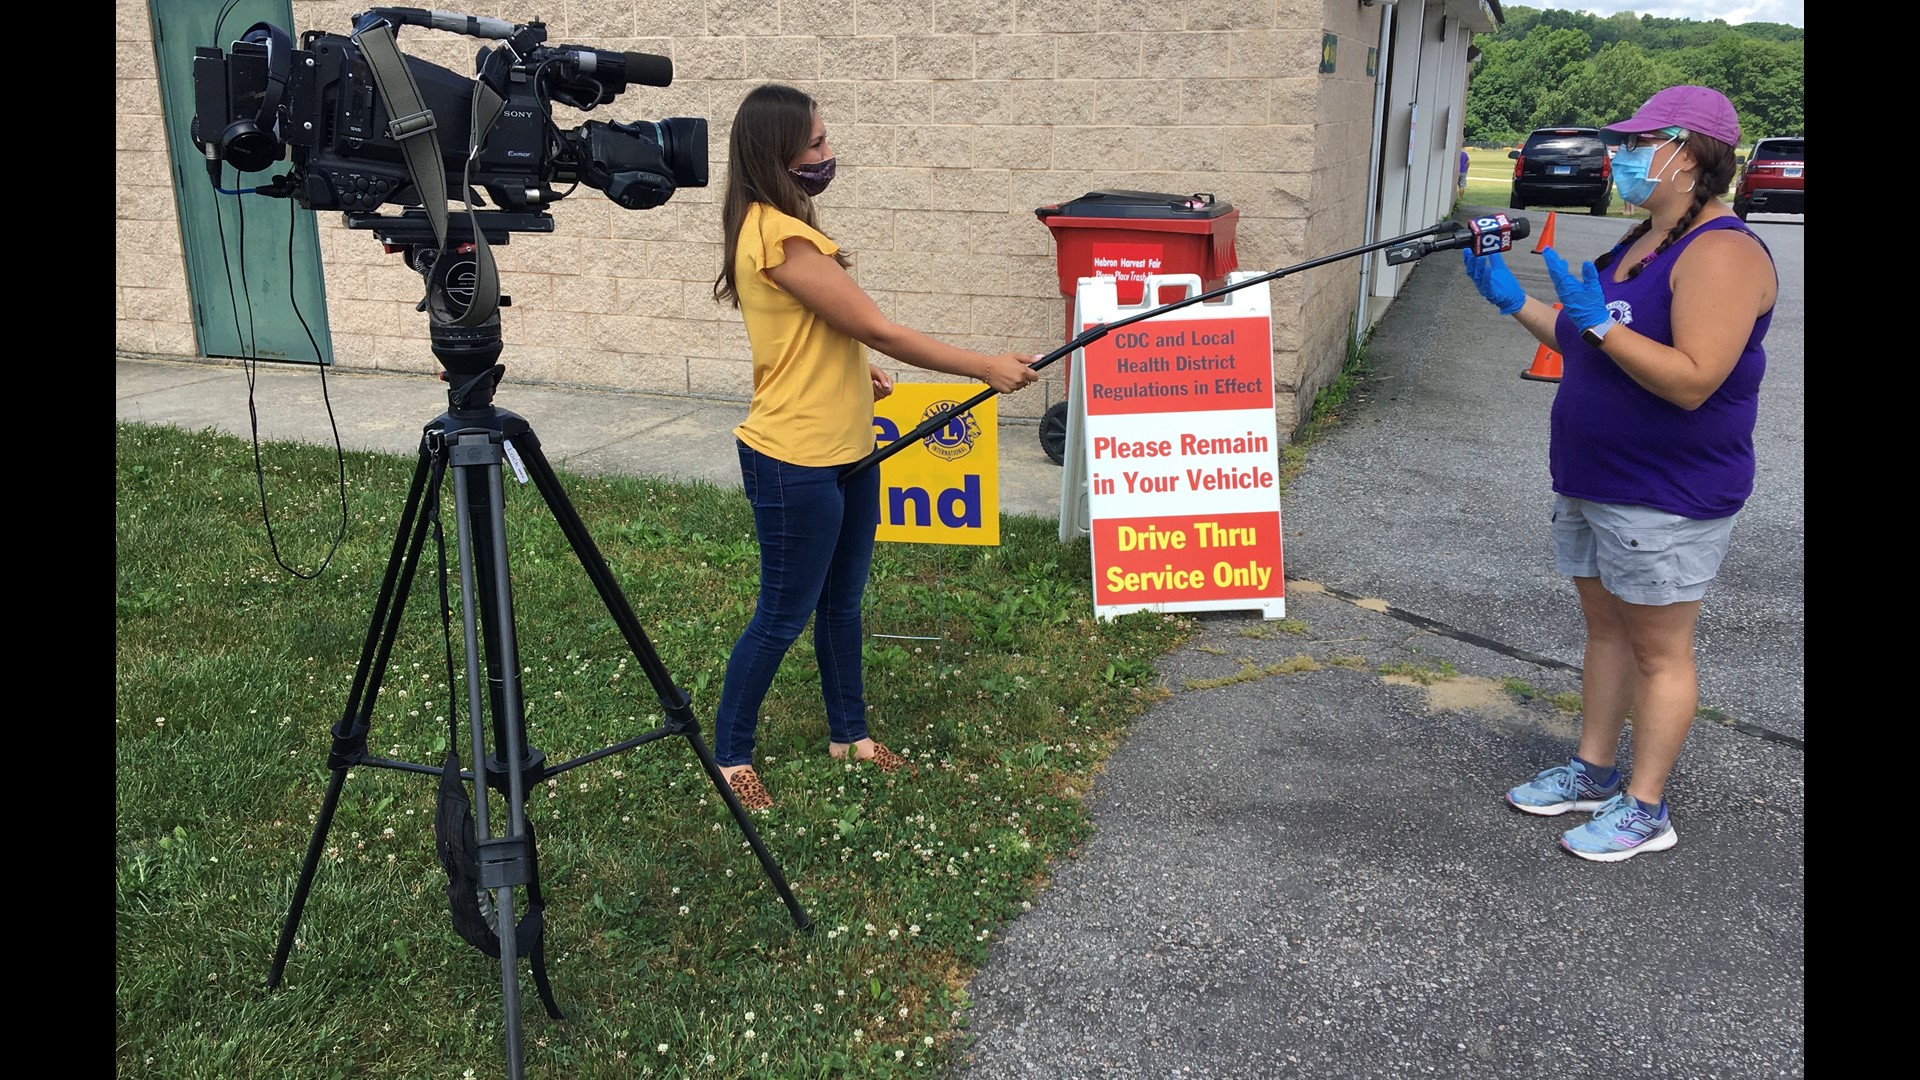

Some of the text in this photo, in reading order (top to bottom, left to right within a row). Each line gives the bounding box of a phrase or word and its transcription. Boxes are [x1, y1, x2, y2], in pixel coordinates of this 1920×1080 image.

[503, 110, 533, 118] SONY
[637, 172, 662, 183] Canon
[1477, 218, 1498, 230] 61
[1496, 214, 1509, 226] FOX
[1482, 234, 1500, 252] 61
[1502, 231, 1510, 248] FOX
[1094, 256, 1162, 269] Hebron Harvest Fair
[1114, 270, 1130, 281] Place
[1115, 329, 1235, 349] CDC and Local
[1117, 355, 1236, 374] Health District
[1093, 378, 1262, 401] Regulations in Effect
[942, 424, 958, 440] L
[1094, 431, 1268, 460] Please Remain
[507, 447, 519, 468] Lock
[1094, 466, 1273, 495] in Your Vehicle
[877, 474, 982, 528] nd
[1118, 522, 1256, 552] Drive Thru
[1106, 561, 1272, 592] Service Only
